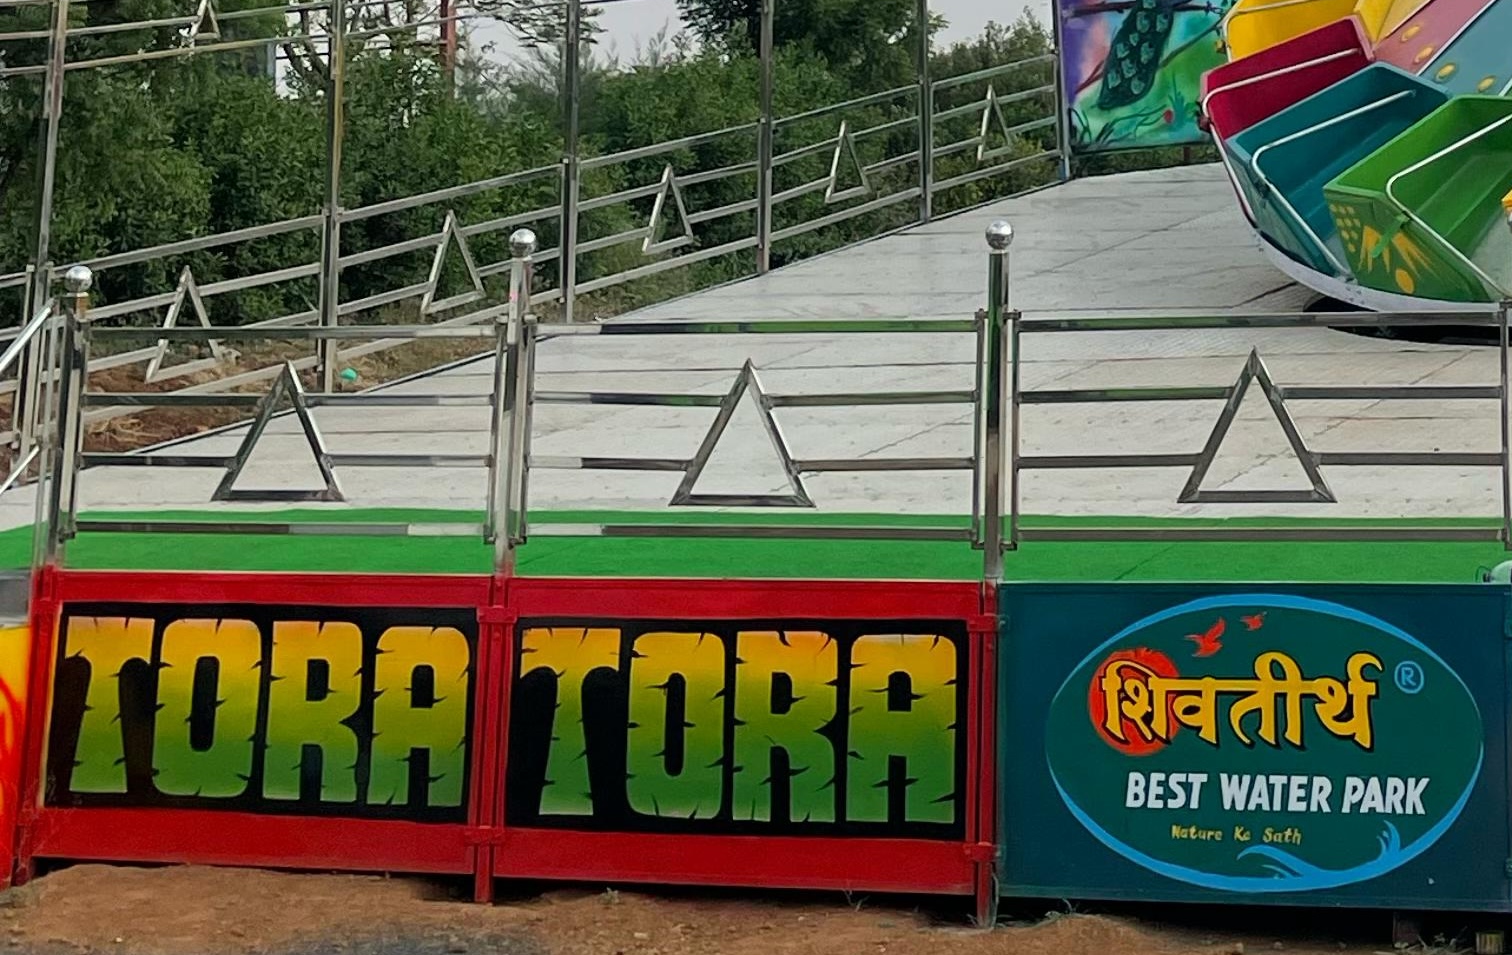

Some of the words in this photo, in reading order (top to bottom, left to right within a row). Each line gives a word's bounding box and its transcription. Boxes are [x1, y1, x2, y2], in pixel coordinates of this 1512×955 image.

[65, 616, 471, 808] TORA
[519, 626, 959, 824] TORA
[1101, 650, 1384, 750] शिवतीर्थ
[1125, 771, 1208, 810] BEST
[1219, 772, 1333, 813] WATER
[1341, 776, 1430, 815] PARK
[1171, 824, 1223, 841] Nature
[1262, 827, 1302, 845] Sath
